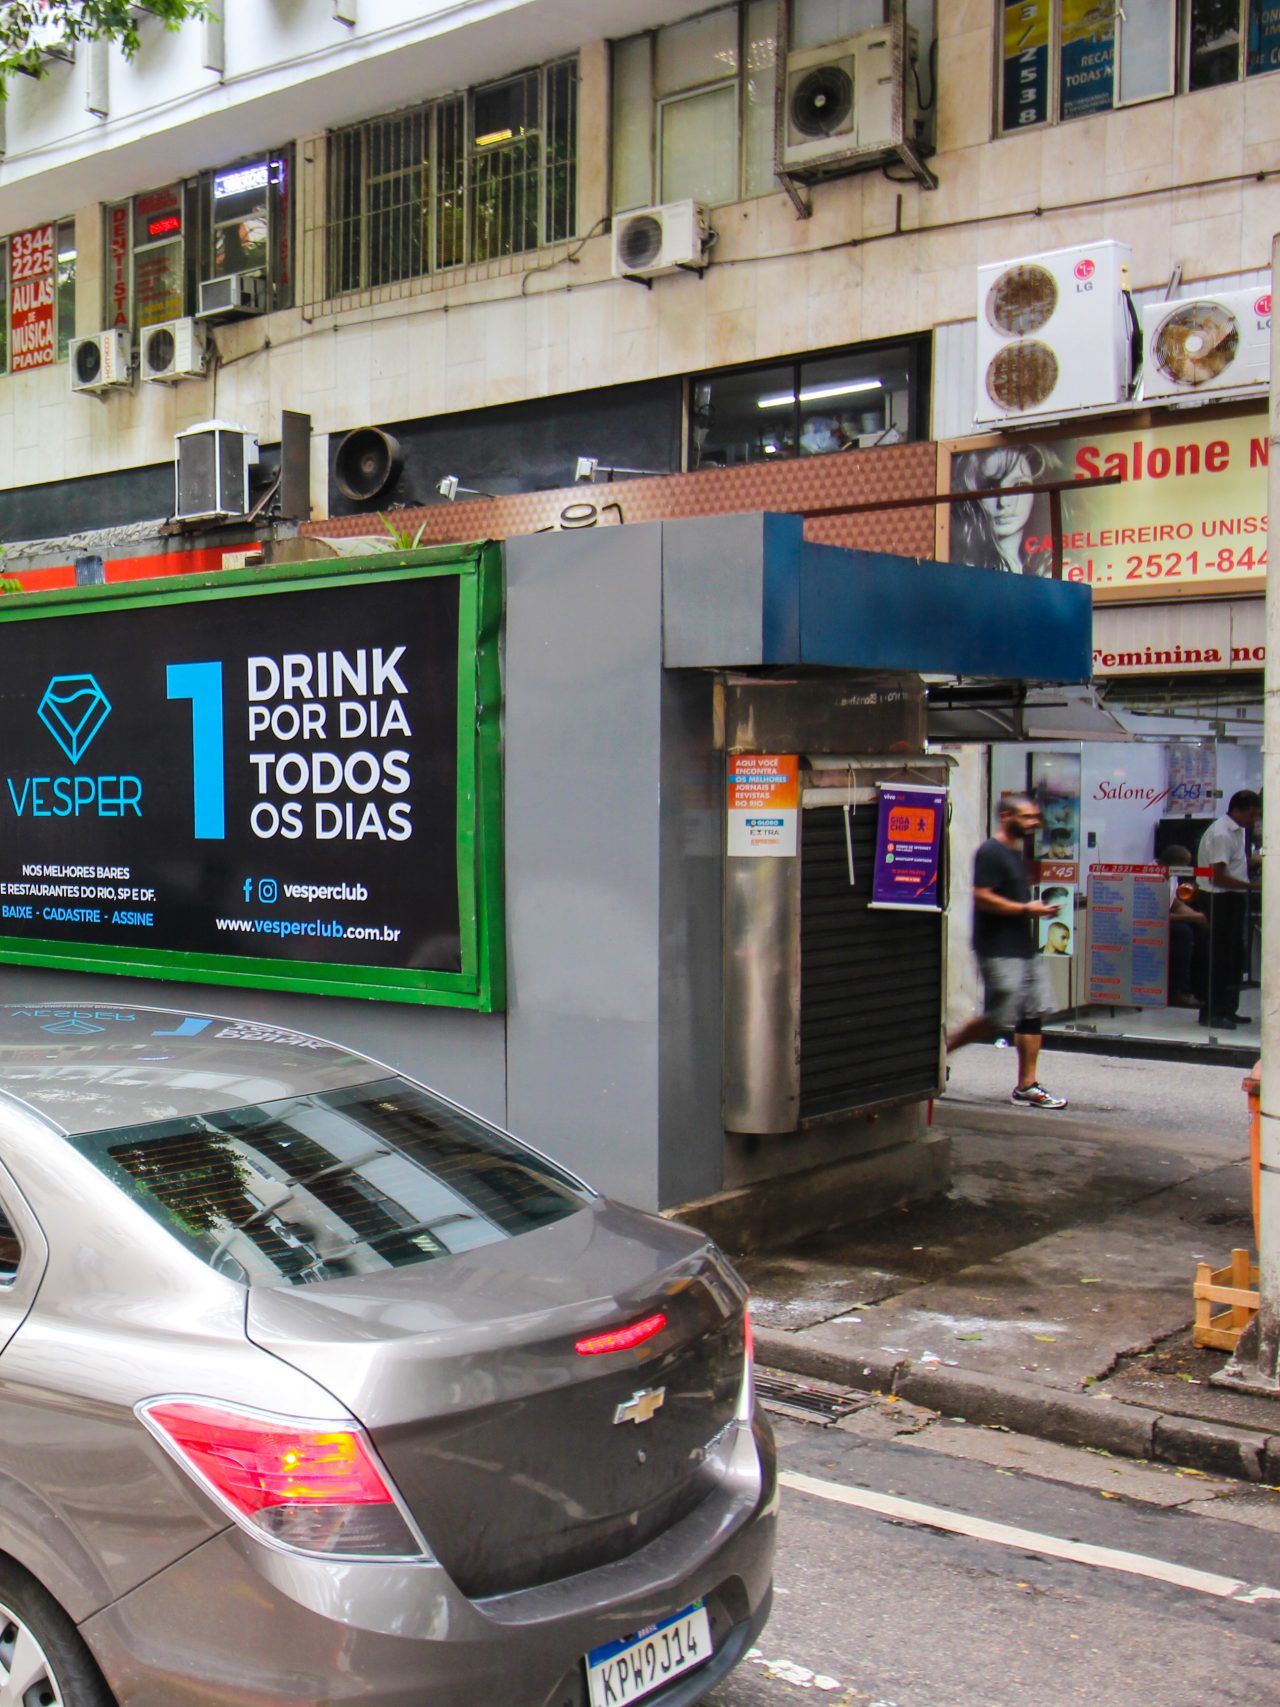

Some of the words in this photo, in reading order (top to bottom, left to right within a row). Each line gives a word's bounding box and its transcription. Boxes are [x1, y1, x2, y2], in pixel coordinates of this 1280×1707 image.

[1066, 69, 1101, 87] TODAS
[12, 227, 53, 257] 3344
[12, 249, 53, 280] 2225
[112, 208, 127, 326] DENTISTA
[13, 278, 54, 314] AULAS
[1076, 281, 1093, 293] LG
[27, 311, 36, 323] DE
[12, 318, 52, 355] MÚSICA
[13, 350, 52, 370] PIANO
[1074, 439, 1230, 482] Salone
[1025, 522, 1193, 554] CABELEIREIRO
[1049, 559, 1113, 583] el.:
[1092, 644, 1222, 668] Feminina
[248, 646, 409, 702] DRINK
[249, 706, 326, 741] POR
[340, 699, 412, 738] DIA
[166, 661, 225, 839] 1
[758, 758, 779, 767] VOCÊ
[250, 750, 411, 794] TODOS
[7, 776, 142, 817] VESPER
[1093, 781, 1155, 801] Salone
[251, 802, 304, 840] OS
[316, 801, 413, 841] DIAS
[23, 864, 42, 876] NOS
[44, 865, 95, 878] MELHORES
[97, 867, 130, 879] BARES
[0, 883, 7, 895] E
[8, 884, 80, 898] RESTAURANTES
[81, 887, 96, 898] DO
[97, 888, 117, 901] RIO,
[118, 888, 131, 900] SP
[132, 889, 139, 900] E
[140, 889, 157, 902] DF.
[284, 883, 368, 903] vesperclub
[2, 905, 33, 919] BAIXE
[43, 907, 101, 923] CADASTRE
[112, 911, 154, 926] ASSINE
[216, 919, 401, 942] www.vesperclub.com.br
[602, 1620, 698, 1707] KPW9J14
